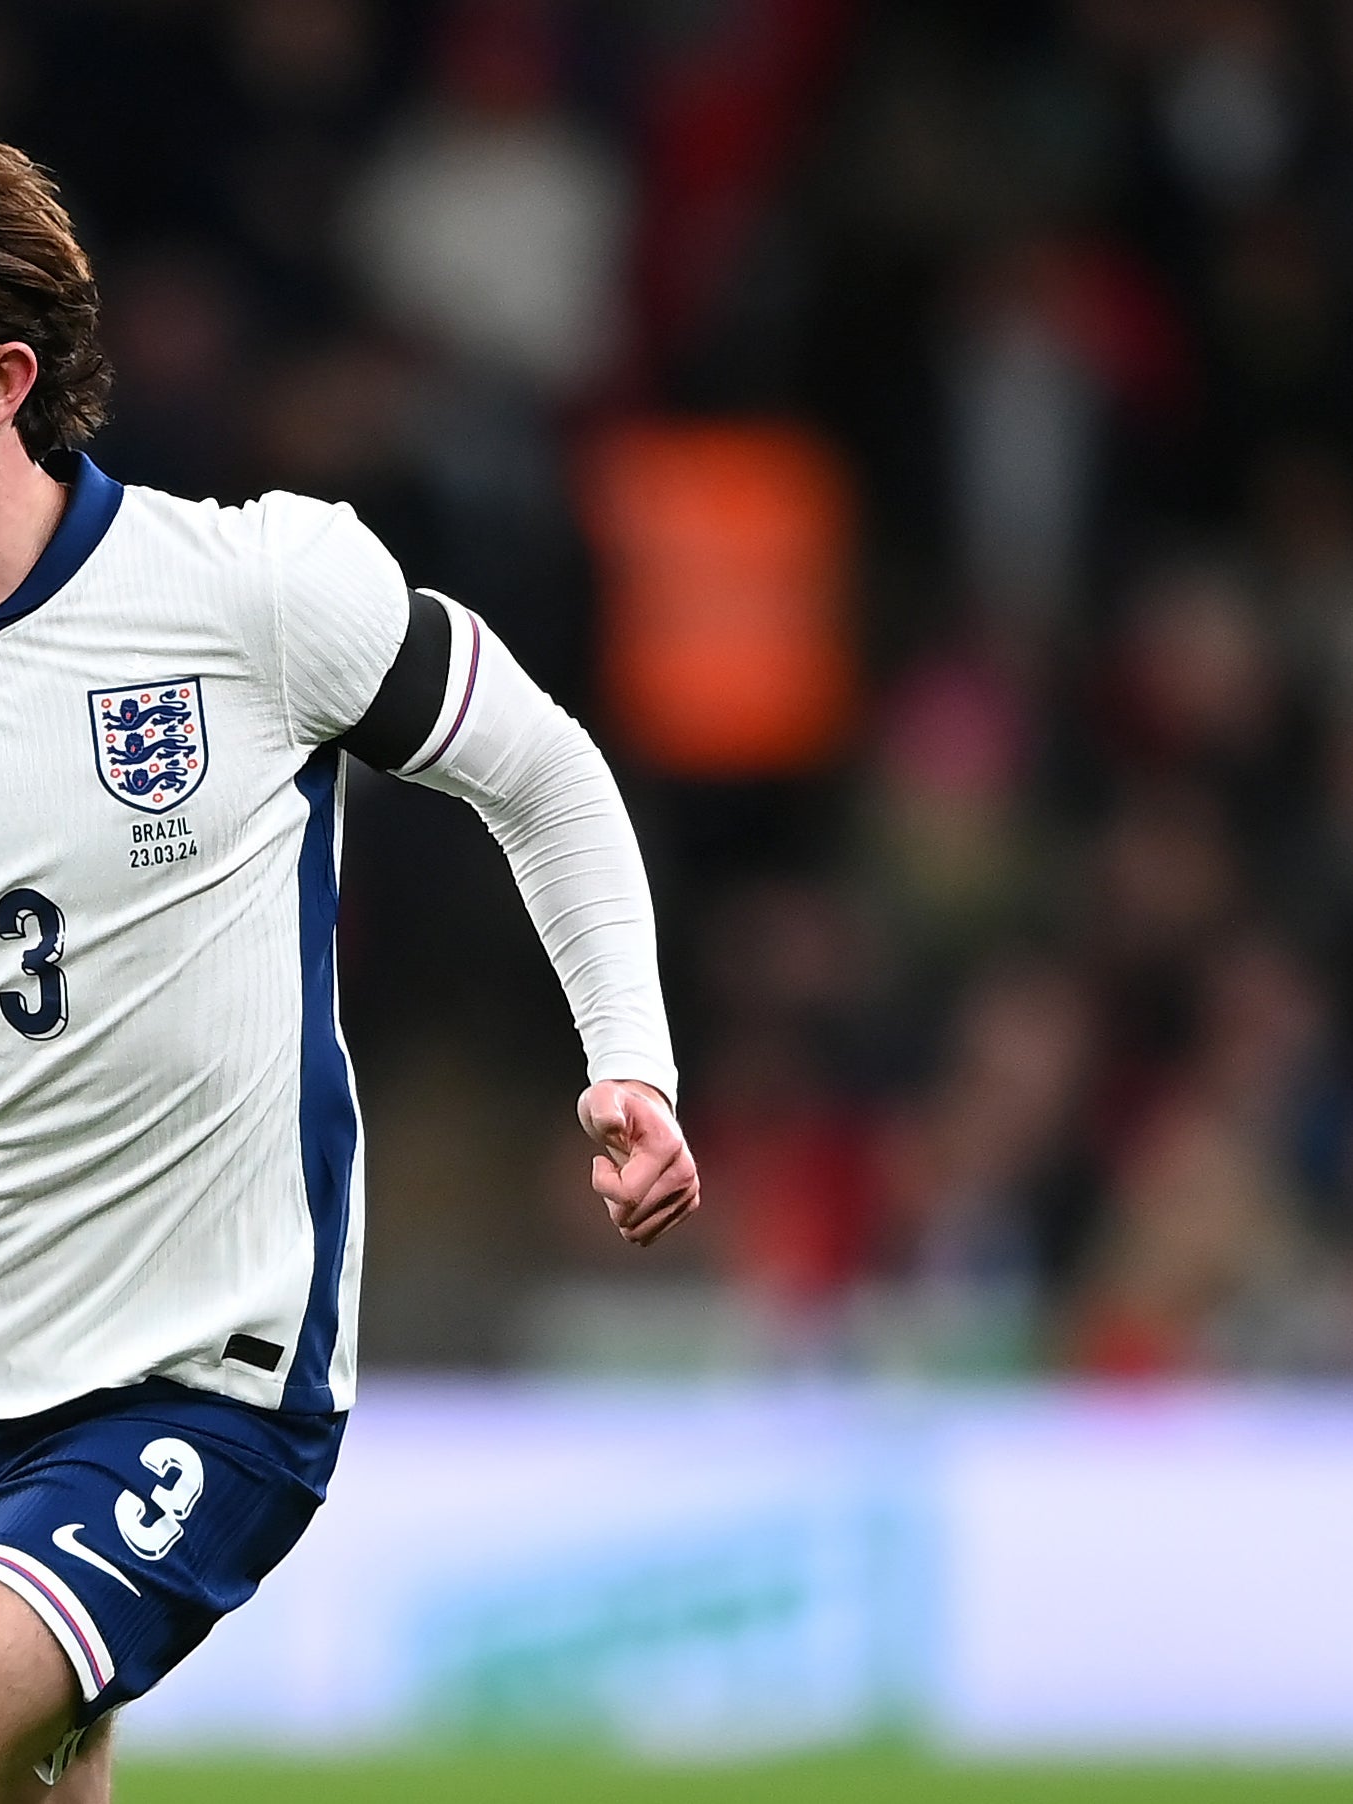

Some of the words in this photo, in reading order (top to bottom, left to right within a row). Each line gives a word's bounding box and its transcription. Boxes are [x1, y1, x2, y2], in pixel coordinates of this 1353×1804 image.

[132, 817, 192, 843] BRAZIL
[129, 840, 197, 868] 23.03.24
[114, 1437, 203, 1560] 3
